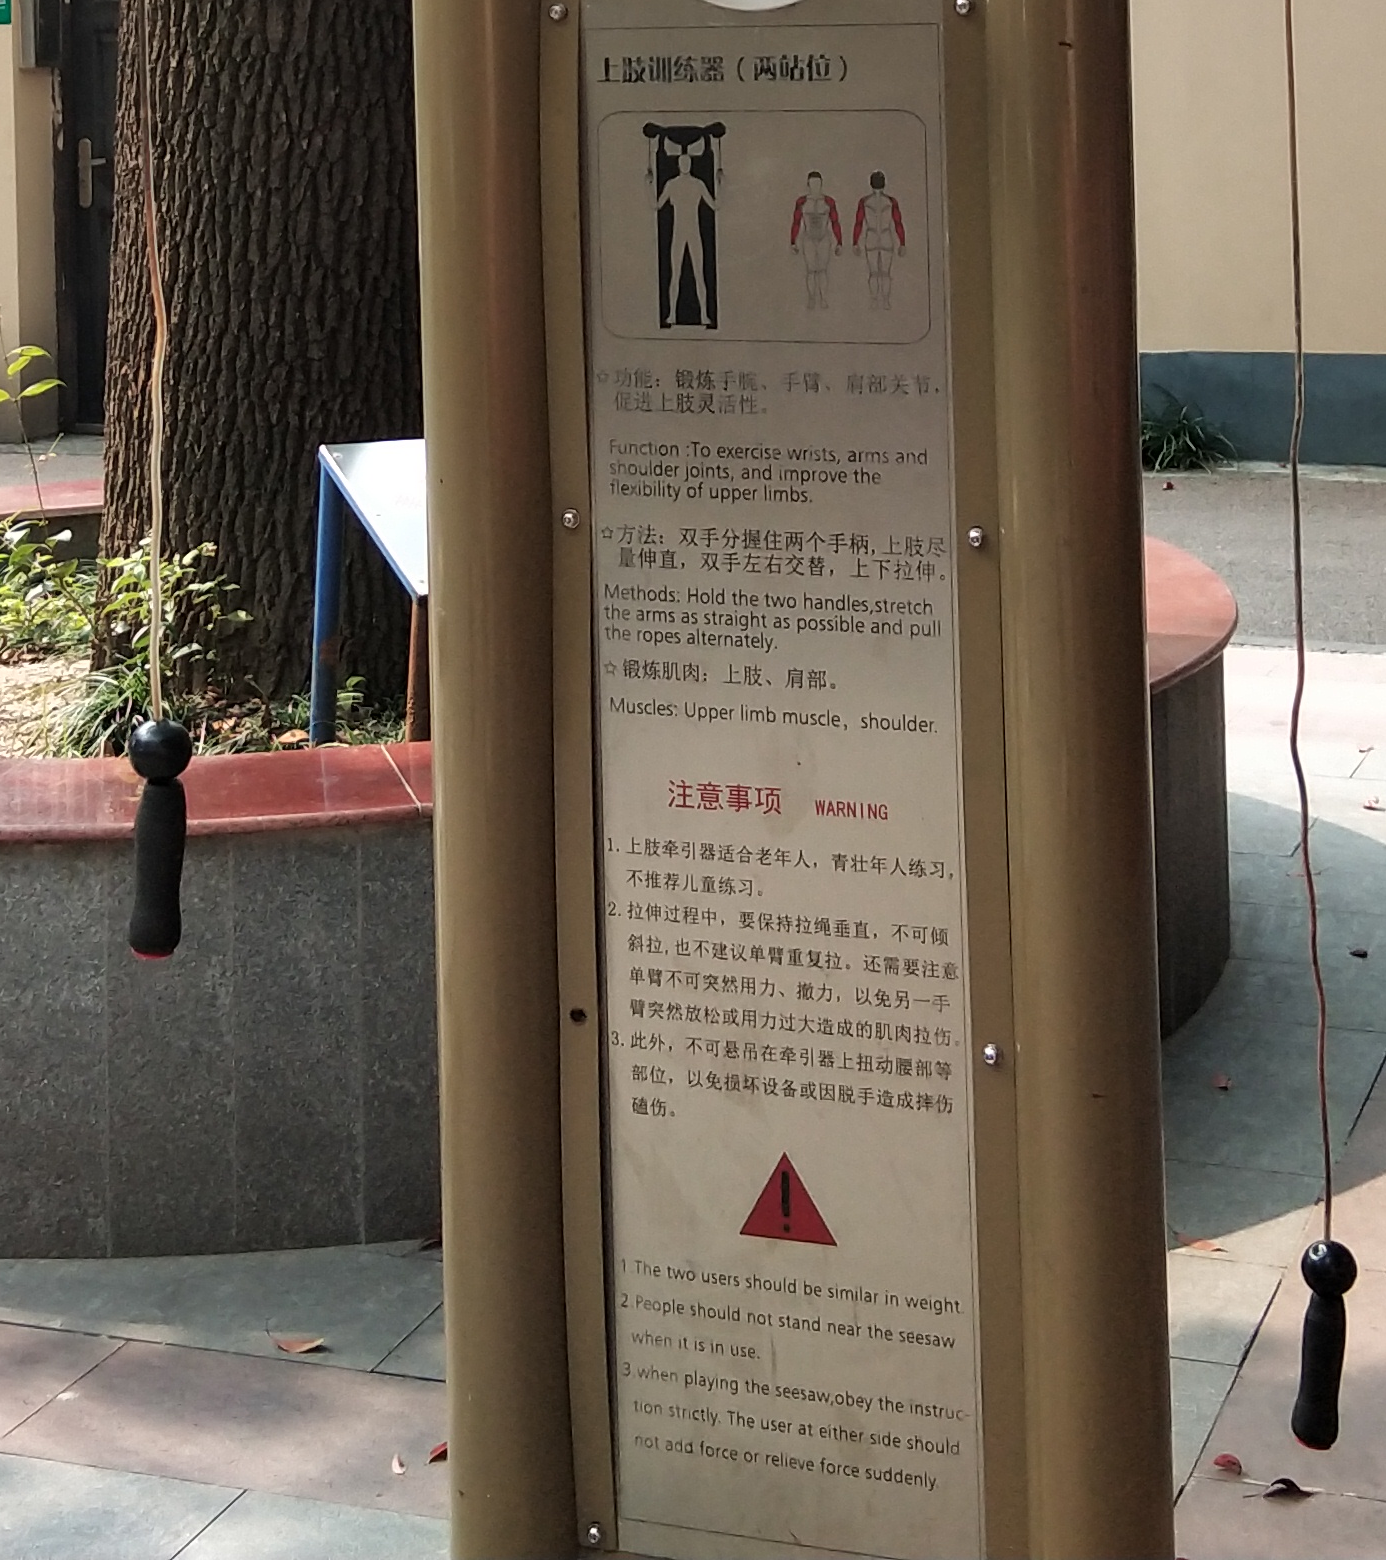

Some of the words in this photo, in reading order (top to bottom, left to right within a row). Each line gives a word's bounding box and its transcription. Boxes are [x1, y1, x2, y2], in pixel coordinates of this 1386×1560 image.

[609, 459, 680, 478] shoulder
[684, 461, 734, 482] joints,
[741, 464, 773, 482] and
[778, 466, 848, 486] improve
[853, 467, 882, 485] the
[716, 443, 782, 461] exercise
[787, 444, 841, 465] wrists,
[847, 449, 889, 464] arms
[895, 448, 928, 466] and
[609, 478, 681, 502] flexibility
[686, 481, 704, 499] of
[709, 485, 758, 504] upper
[764, 484, 813, 503] limbs.
[604, 583, 681, 604] Methods:
[687, 587, 726, 606] Hold
[731, 588, 759, 607] the
[764, 592, 797, 609] two
[604, 603, 631, 622] the
[636, 608, 676, 624] arms
[680, 610, 698, 625] as
[703, 609, 768, 632] straight
[773, 615, 791, 630] as
[797, 614, 865, 634] possible
[870, 618, 903, 636] and
[910, 620, 942, 640] pull
[604, 623, 632, 642] the
[636, 629, 682, 647] ropes
[686, 627, 779, 654] alternately.
[609, 696, 679, 717] Muscles:
[684, 700, 735, 724] Upper
[740, 703, 777, 724] limb
[860, 711, 939, 735] shoulder.
[667, 779, 783, 816] 注意事项
[814, 798, 889, 821] WARNING
[626, 868, 764, 898] 不推荐儿童练习。
[667, 1265, 696, 1282] two
[701, 1270, 740, 1287] users
[745, 1273, 798, 1294] should
[803, 1279, 822, 1298] be
[827, 1282, 879, 1304] similar
[884, 1289, 900, 1307] in
[690, 1301, 741, 1322] should
[746, 1310, 773, 1327] not
[778, 1313, 821, 1333] stand
[827, 1321, 862, 1338] near
[867, 1321, 894, 1341] the
[898, 1330, 957, 1349] seesaw
[631, 1329, 672, 1348] when
[678, 1337, 689, 1350] it
[694, 1338, 706, 1352] is
[710, 1340, 725, 1355] in
[730, 1344, 761, 1360] use.
[684, 1370, 739, 1395] playing
[744, 1378, 770, 1396] the
[878, 1395, 905, 1414] the
[633, 1399, 663, 1416] tion
[727, 1409, 755, 1429] The
[760, 1418, 793, 1434] user
[798, 1422, 813, 1437] at
[819, 1423, 865, 1443] either
[869, 1431, 901, 1449] side
[906, 1435, 961, 1455] should
[634, 1434, 659, 1450] not
[665, 1438, 694, 1455] add
[699, 1440, 738, 1461] force
[743, 1449, 760, 1464] or
[765, 1451, 816, 1472] relieve
[819, 1457, 860, 1479] force
